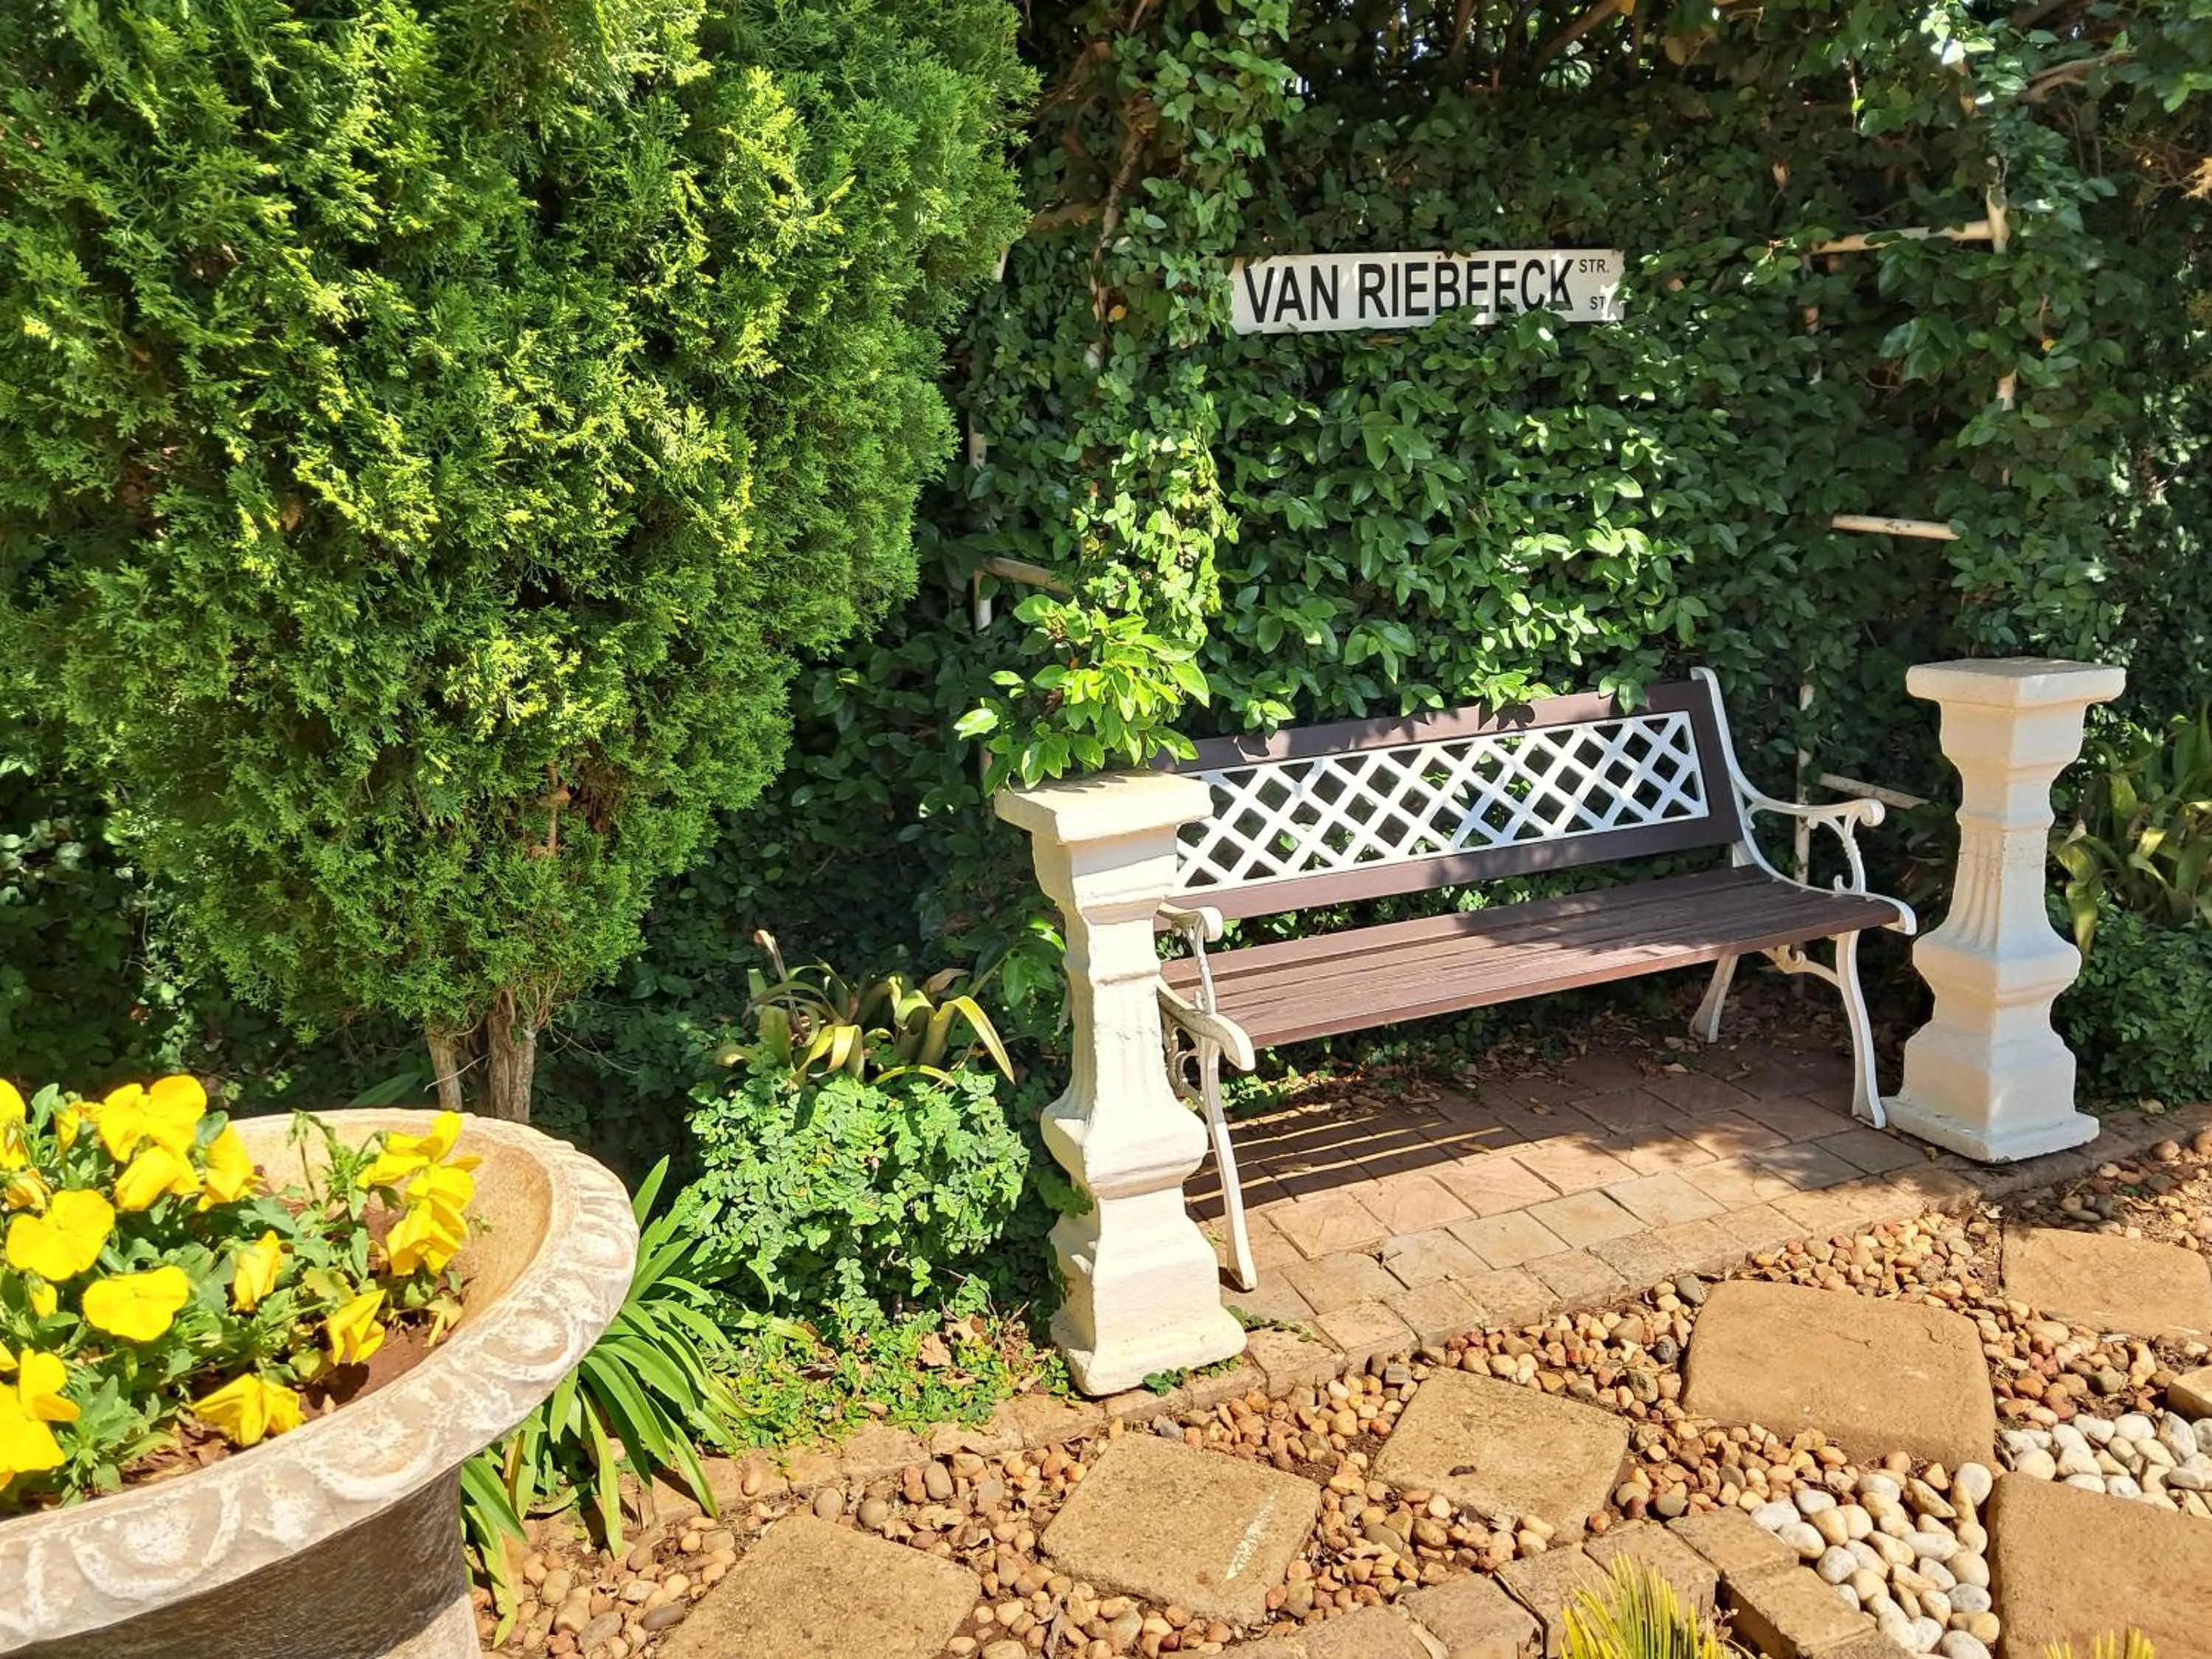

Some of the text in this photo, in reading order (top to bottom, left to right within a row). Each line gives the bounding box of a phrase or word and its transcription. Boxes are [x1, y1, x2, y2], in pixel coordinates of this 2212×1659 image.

[1579, 259, 1610, 274] STR.
[1243, 258, 1575, 323] VAN RIEBEECK
